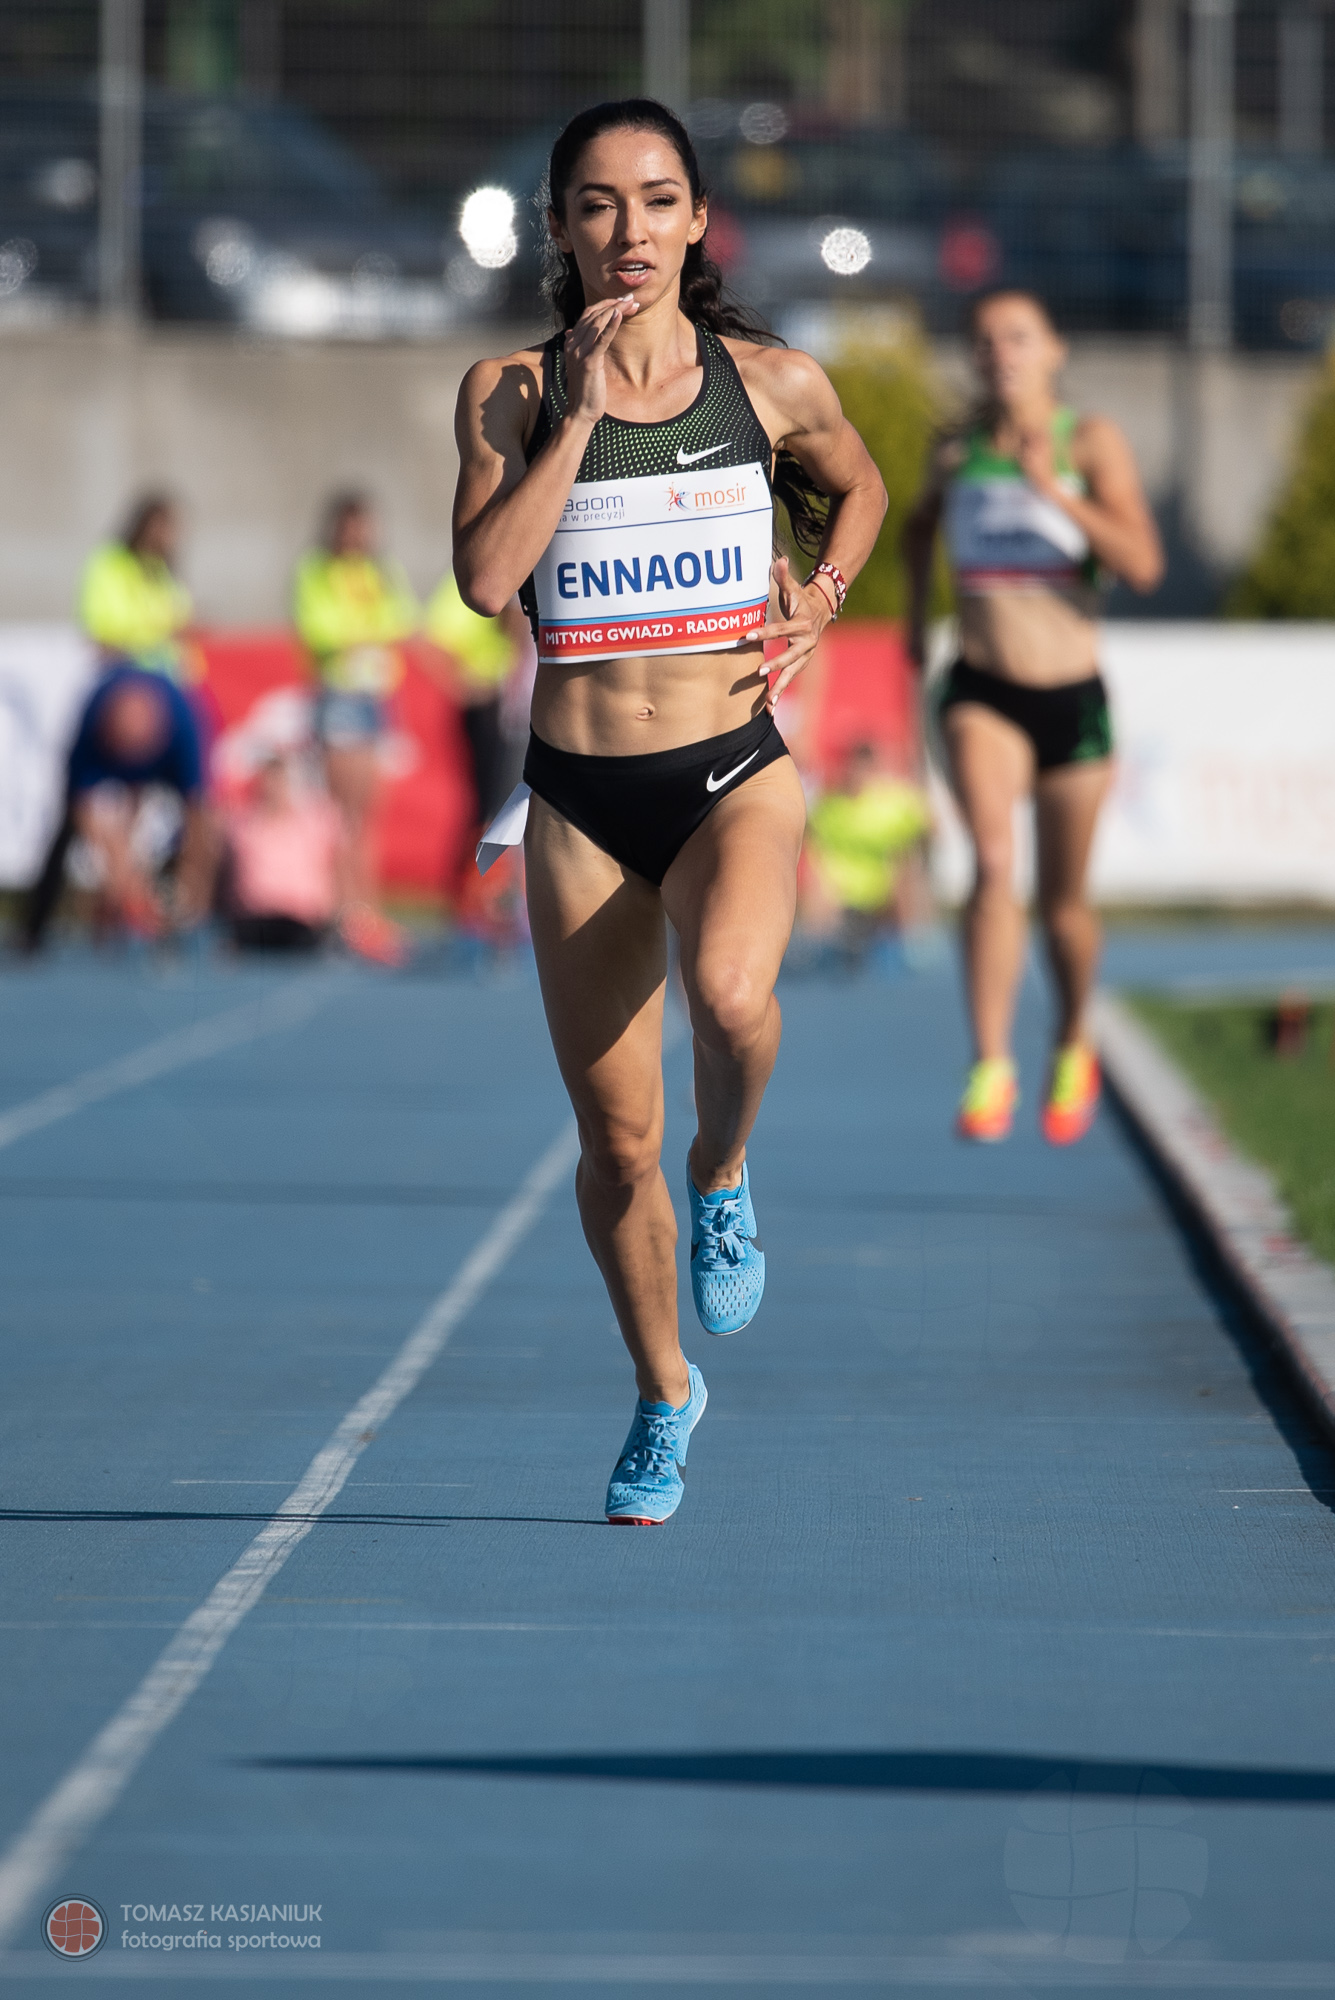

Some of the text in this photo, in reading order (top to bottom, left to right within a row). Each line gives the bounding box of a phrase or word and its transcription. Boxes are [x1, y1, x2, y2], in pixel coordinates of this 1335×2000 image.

[563, 495, 624, 512] adom
[694, 482, 747, 507] mosir
[583, 508, 625, 523] precyzji
[557, 545, 743, 599] ENNAOUI
[545, 629, 603, 645] MITYNG
[606, 623, 674, 642] GWIAZD
[686, 614, 740, 634] RADOM
[742, 609, 761, 627] 2018
